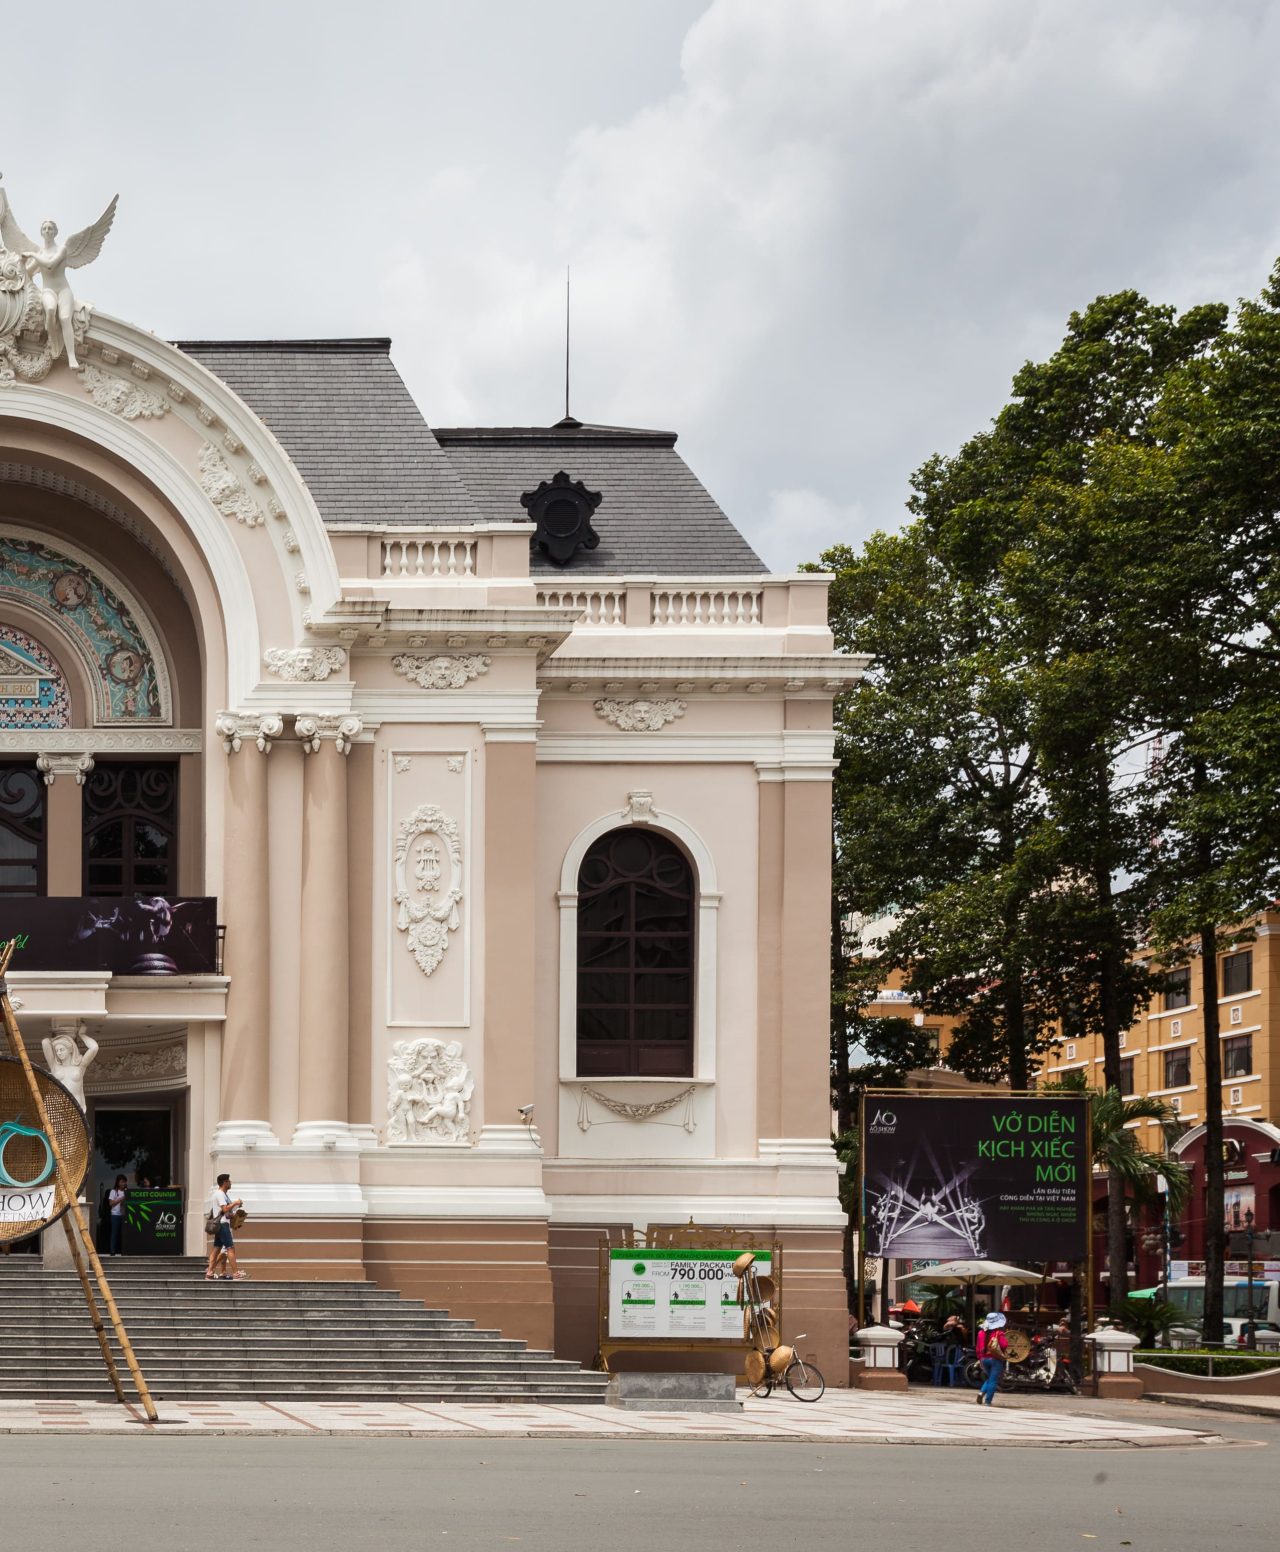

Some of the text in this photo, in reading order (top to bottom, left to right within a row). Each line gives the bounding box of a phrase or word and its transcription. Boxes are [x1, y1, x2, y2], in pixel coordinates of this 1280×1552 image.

[992, 1110, 1075, 1133] VỞ DIỄN
[978, 1136, 1075, 1160] KỊCH XIẾC
[1036, 1162, 1076, 1182] MỚI
[670, 1268, 724, 1280] 790.000
